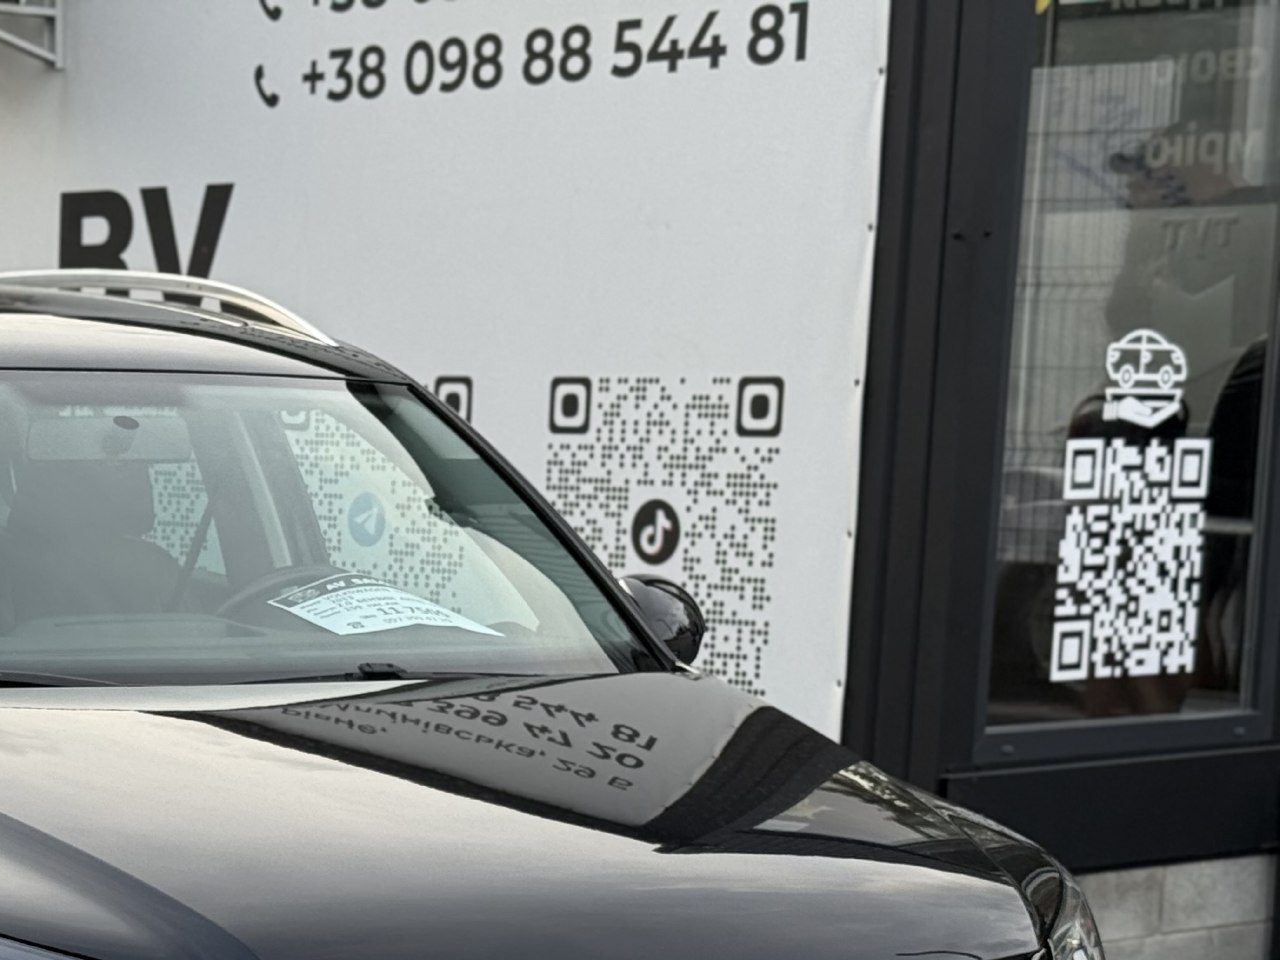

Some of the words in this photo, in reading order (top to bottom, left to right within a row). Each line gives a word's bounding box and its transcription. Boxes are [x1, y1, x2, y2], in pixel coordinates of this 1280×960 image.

[302, 45, 387, 102] +38
[404, 33, 504, 96] 098
[521, 24, 593, 86] 88
[610, 9, 728, 79] 544
[746, 1, 811, 66] 81
[59, 183, 236, 306] RV
